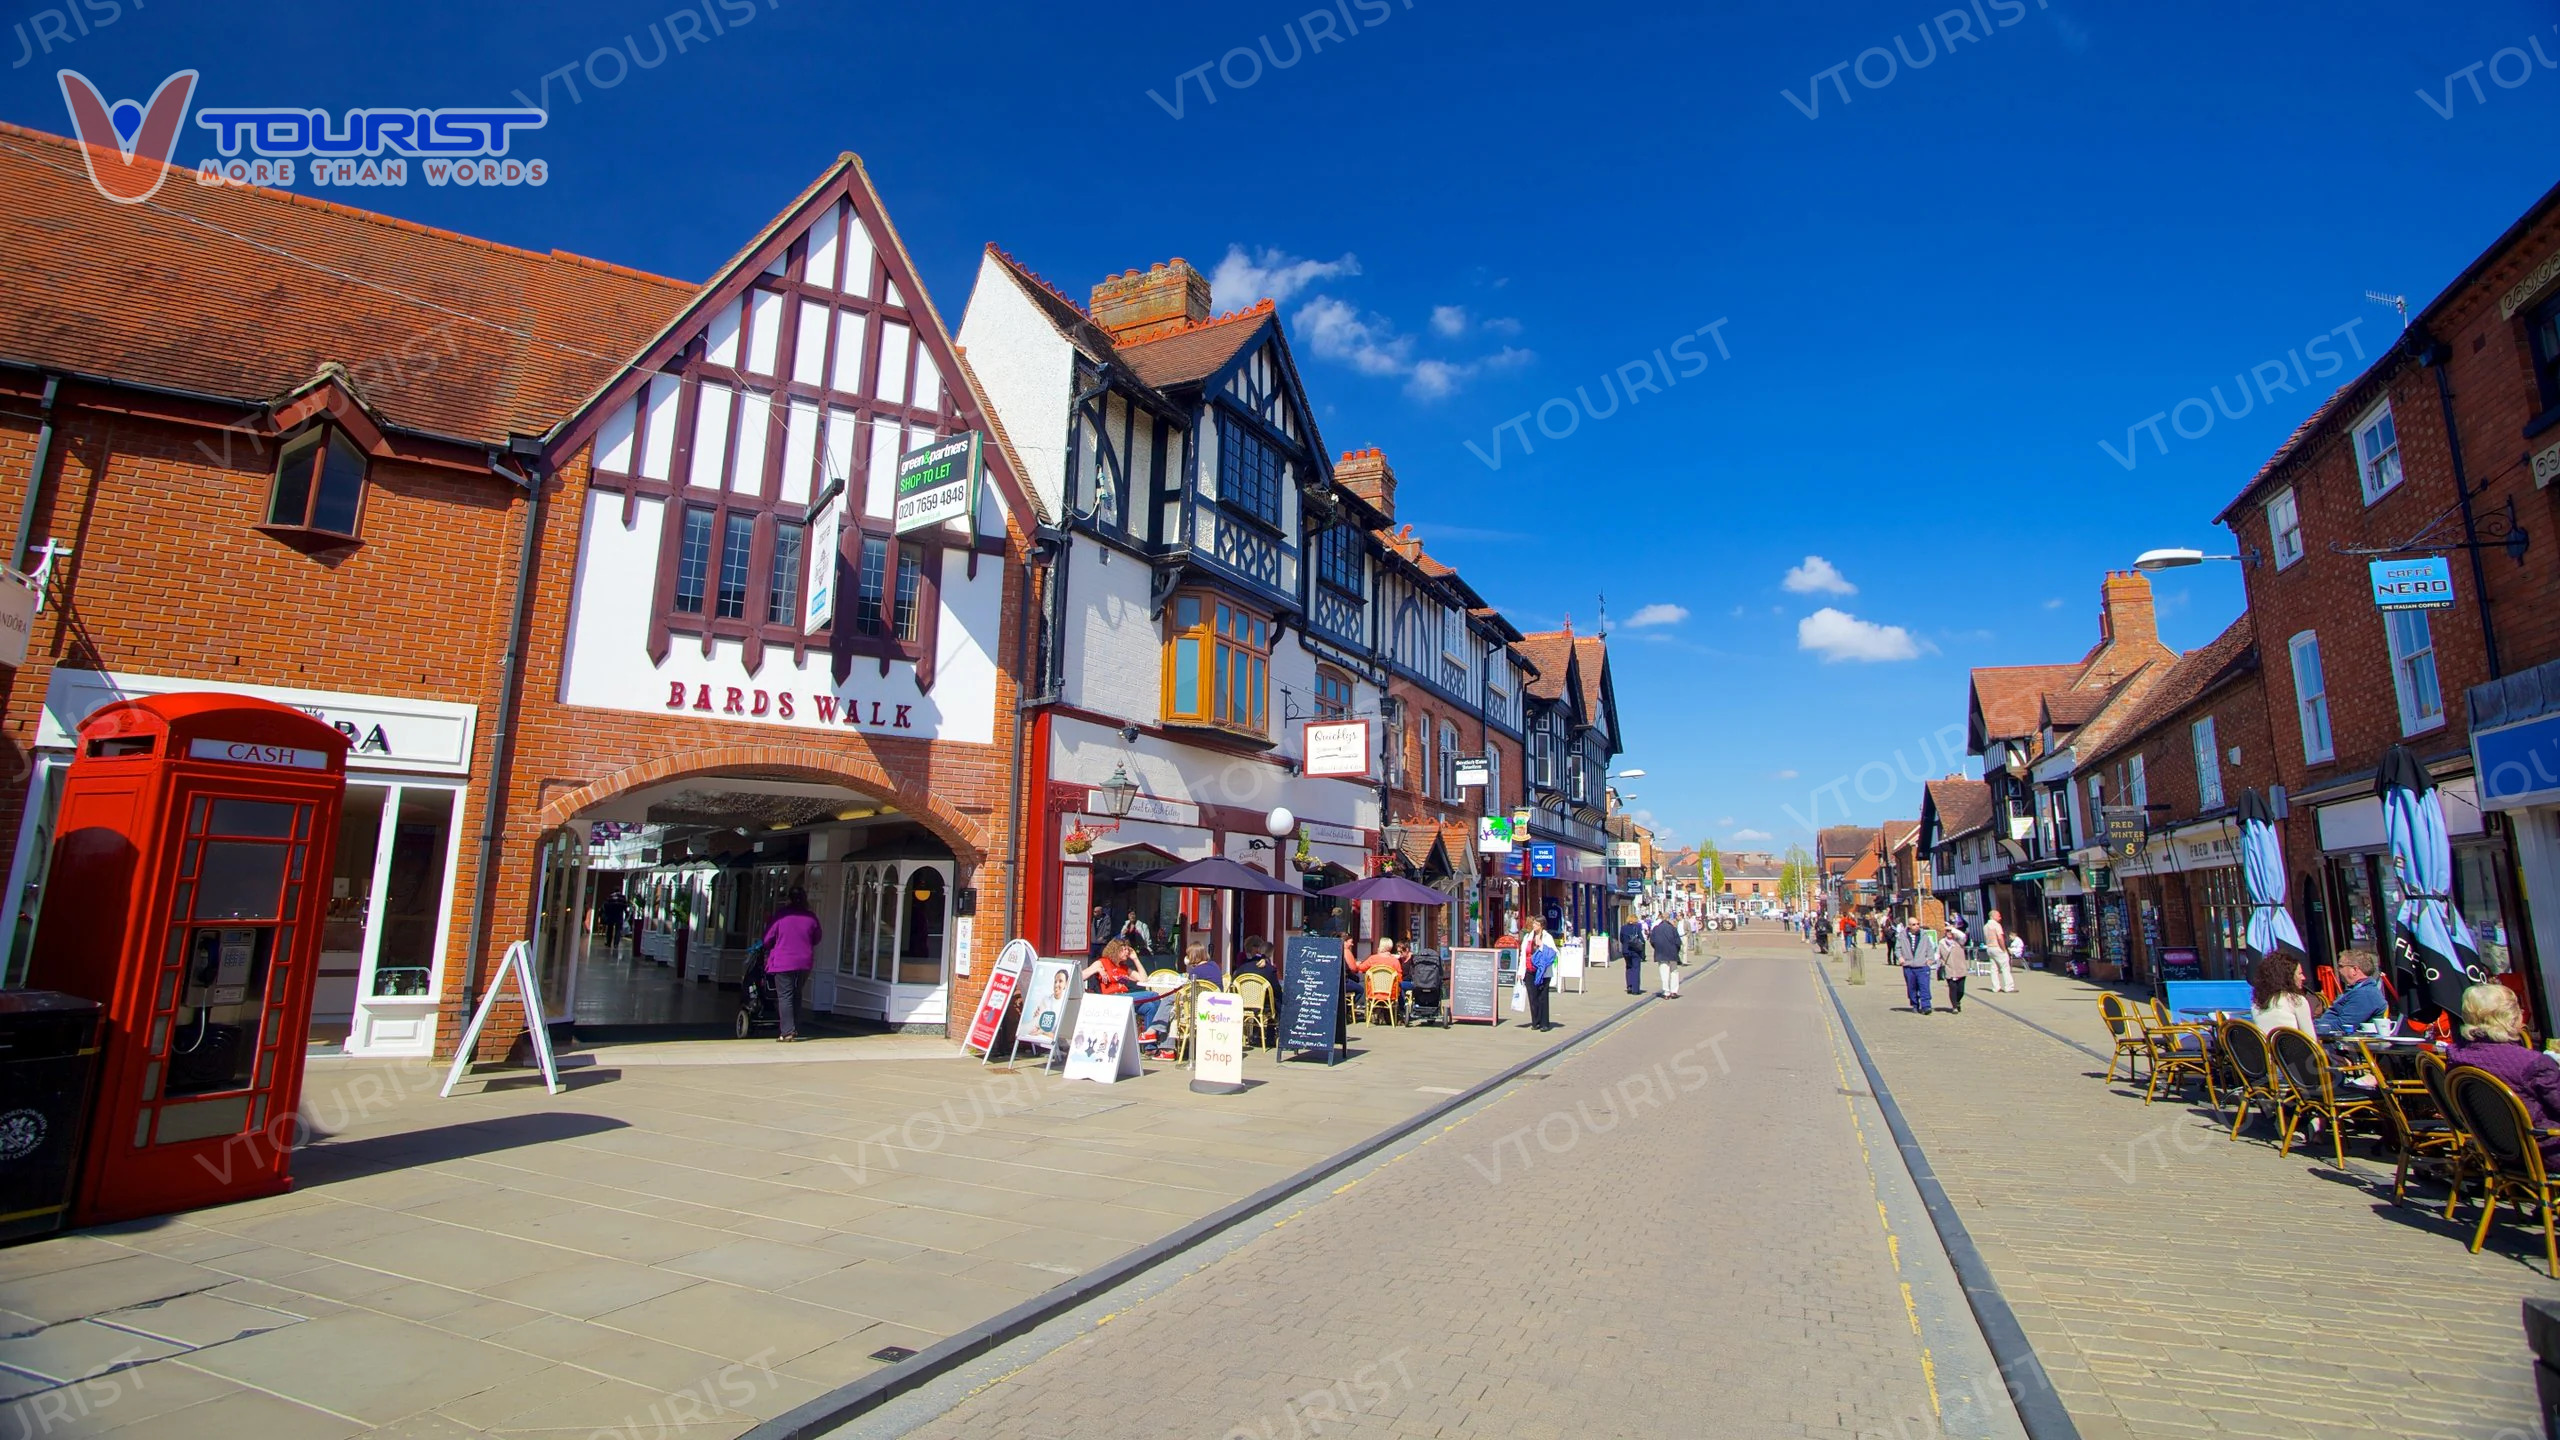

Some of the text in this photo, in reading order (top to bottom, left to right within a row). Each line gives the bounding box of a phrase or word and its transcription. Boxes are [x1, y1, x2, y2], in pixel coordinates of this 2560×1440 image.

[901, 440, 969, 476] green&partners
[900, 463, 951, 493] SHOP TO LET
[899, 501, 914, 520] 020
[916, 494, 938, 514] 7659
[940, 485, 964, 505] 4848
[2378, 580, 2448, 596] NERO
[666, 681, 912, 728] BARDS WALK
[227, 743, 295, 765] CASH
[2111, 821, 2134, 829] FRED
[1480, 827, 1509, 841] jazz
[2112, 831, 2145, 839] WINTER
[2125, 843, 2136, 855] 8
[1208, 1028, 1229, 1044] Toy
[1204, 1050, 1233, 1067] Shop
